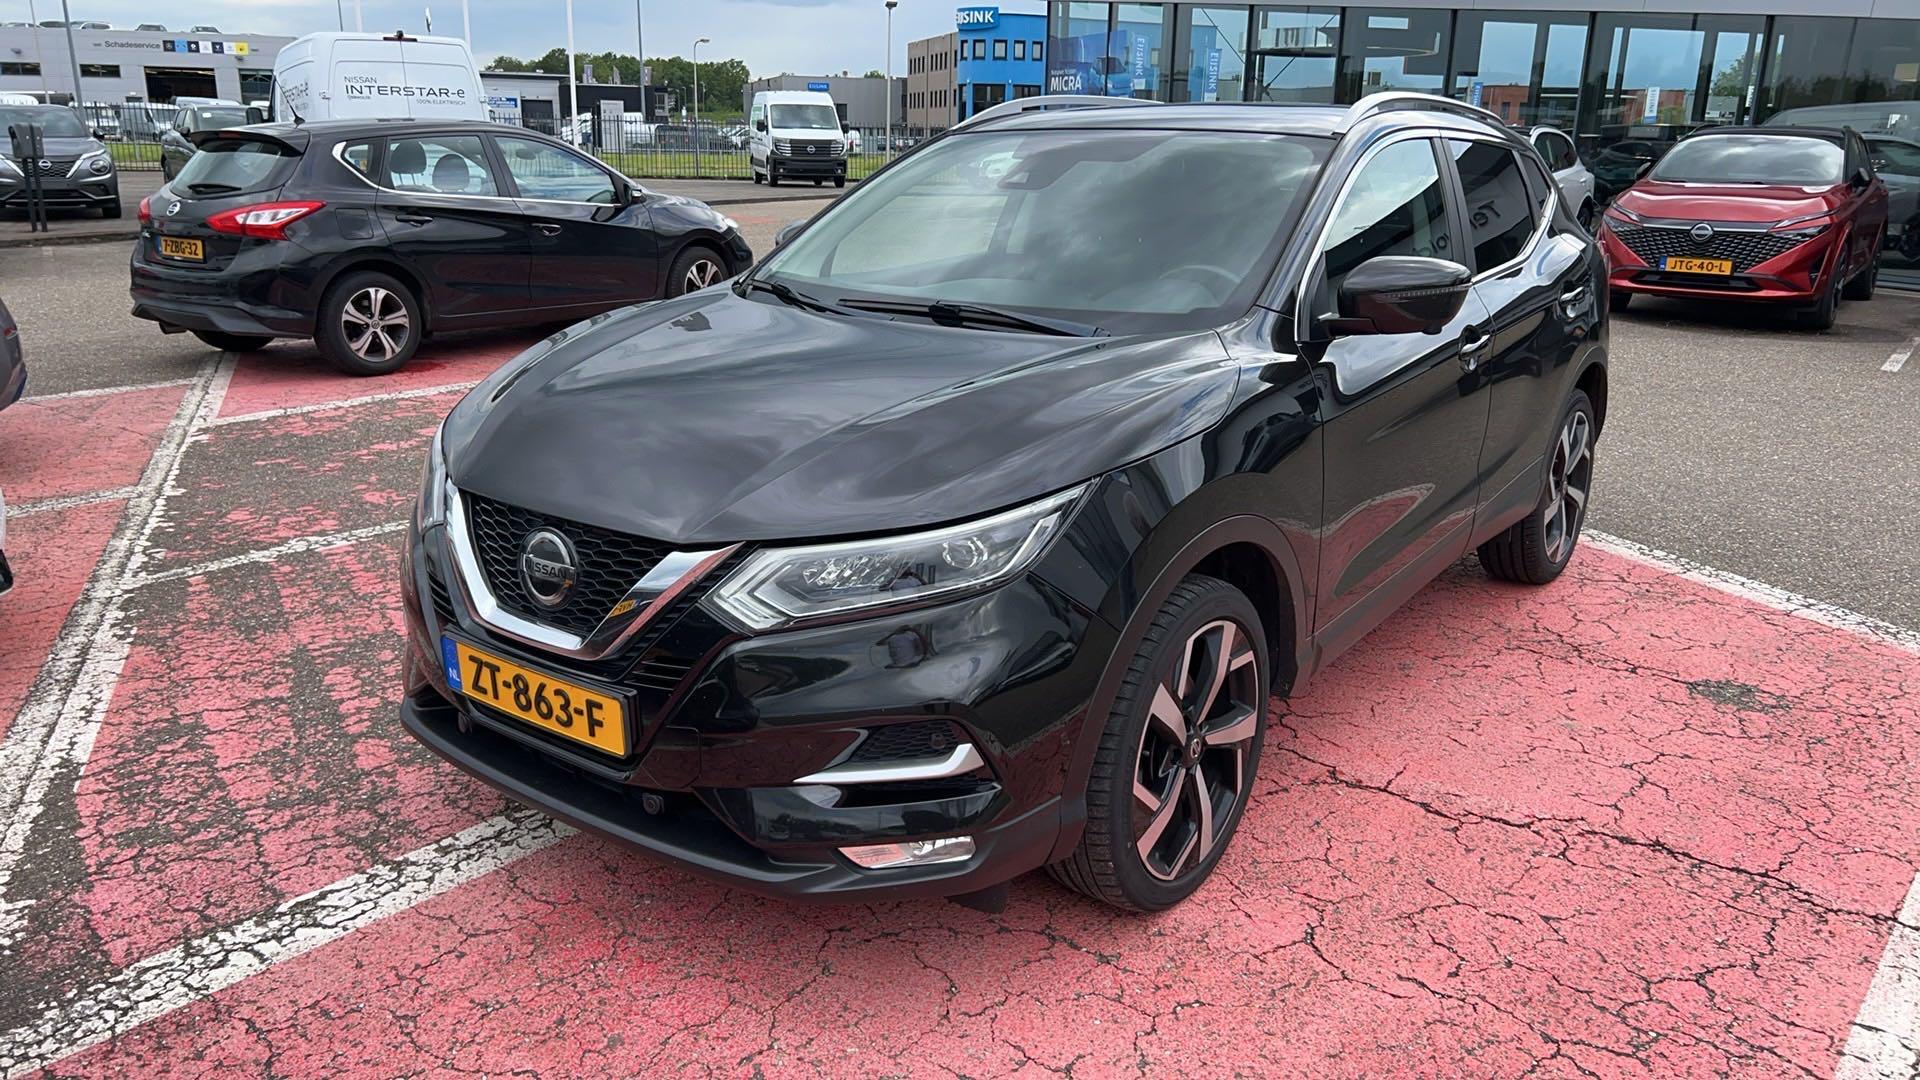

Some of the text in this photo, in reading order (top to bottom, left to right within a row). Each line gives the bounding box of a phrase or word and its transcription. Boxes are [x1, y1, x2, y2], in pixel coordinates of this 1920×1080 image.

[104, 40, 161, 50] Schadeservice
[344, 76, 378, 84] NISSAN
[1051, 74, 1082, 91] MICRA
[345, 84, 465, 98] INTERSTAR-e
[163, 239, 199, 256] 7-ZBG-32
[1670, 260, 1725, 273] JTG-40-L
[527, 559, 568, 579] NISSAN
[448, 654, 604, 738] NL ZT-863-F
